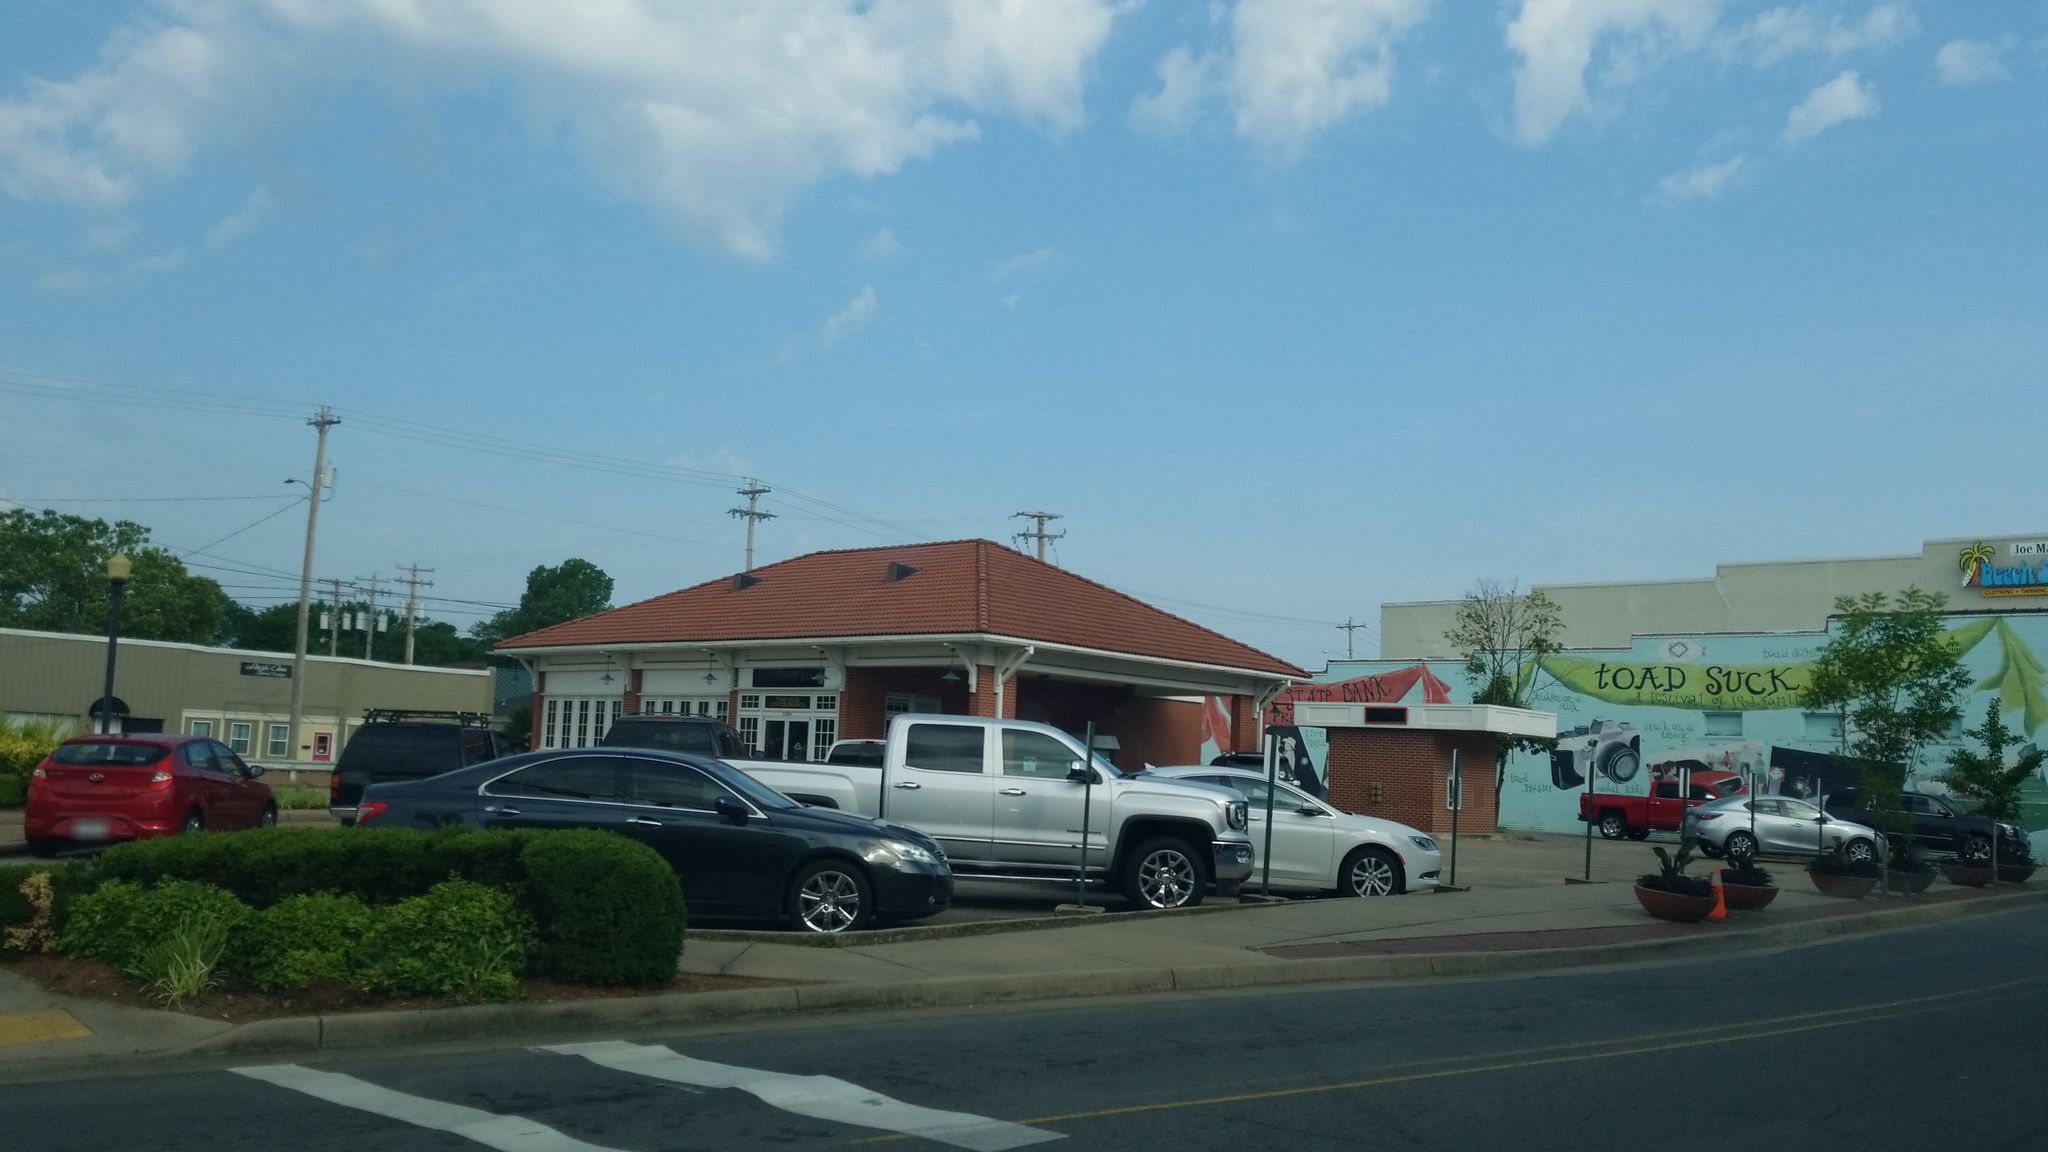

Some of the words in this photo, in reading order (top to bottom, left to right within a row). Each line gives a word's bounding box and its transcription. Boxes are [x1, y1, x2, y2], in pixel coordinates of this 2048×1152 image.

[2014, 545, 2033, 555] Joe
[1980, 560, 2036, 587] Beach
[1343, 676, 1391, 702] BANK
[1706, 666, 1801, 697] SUCK
